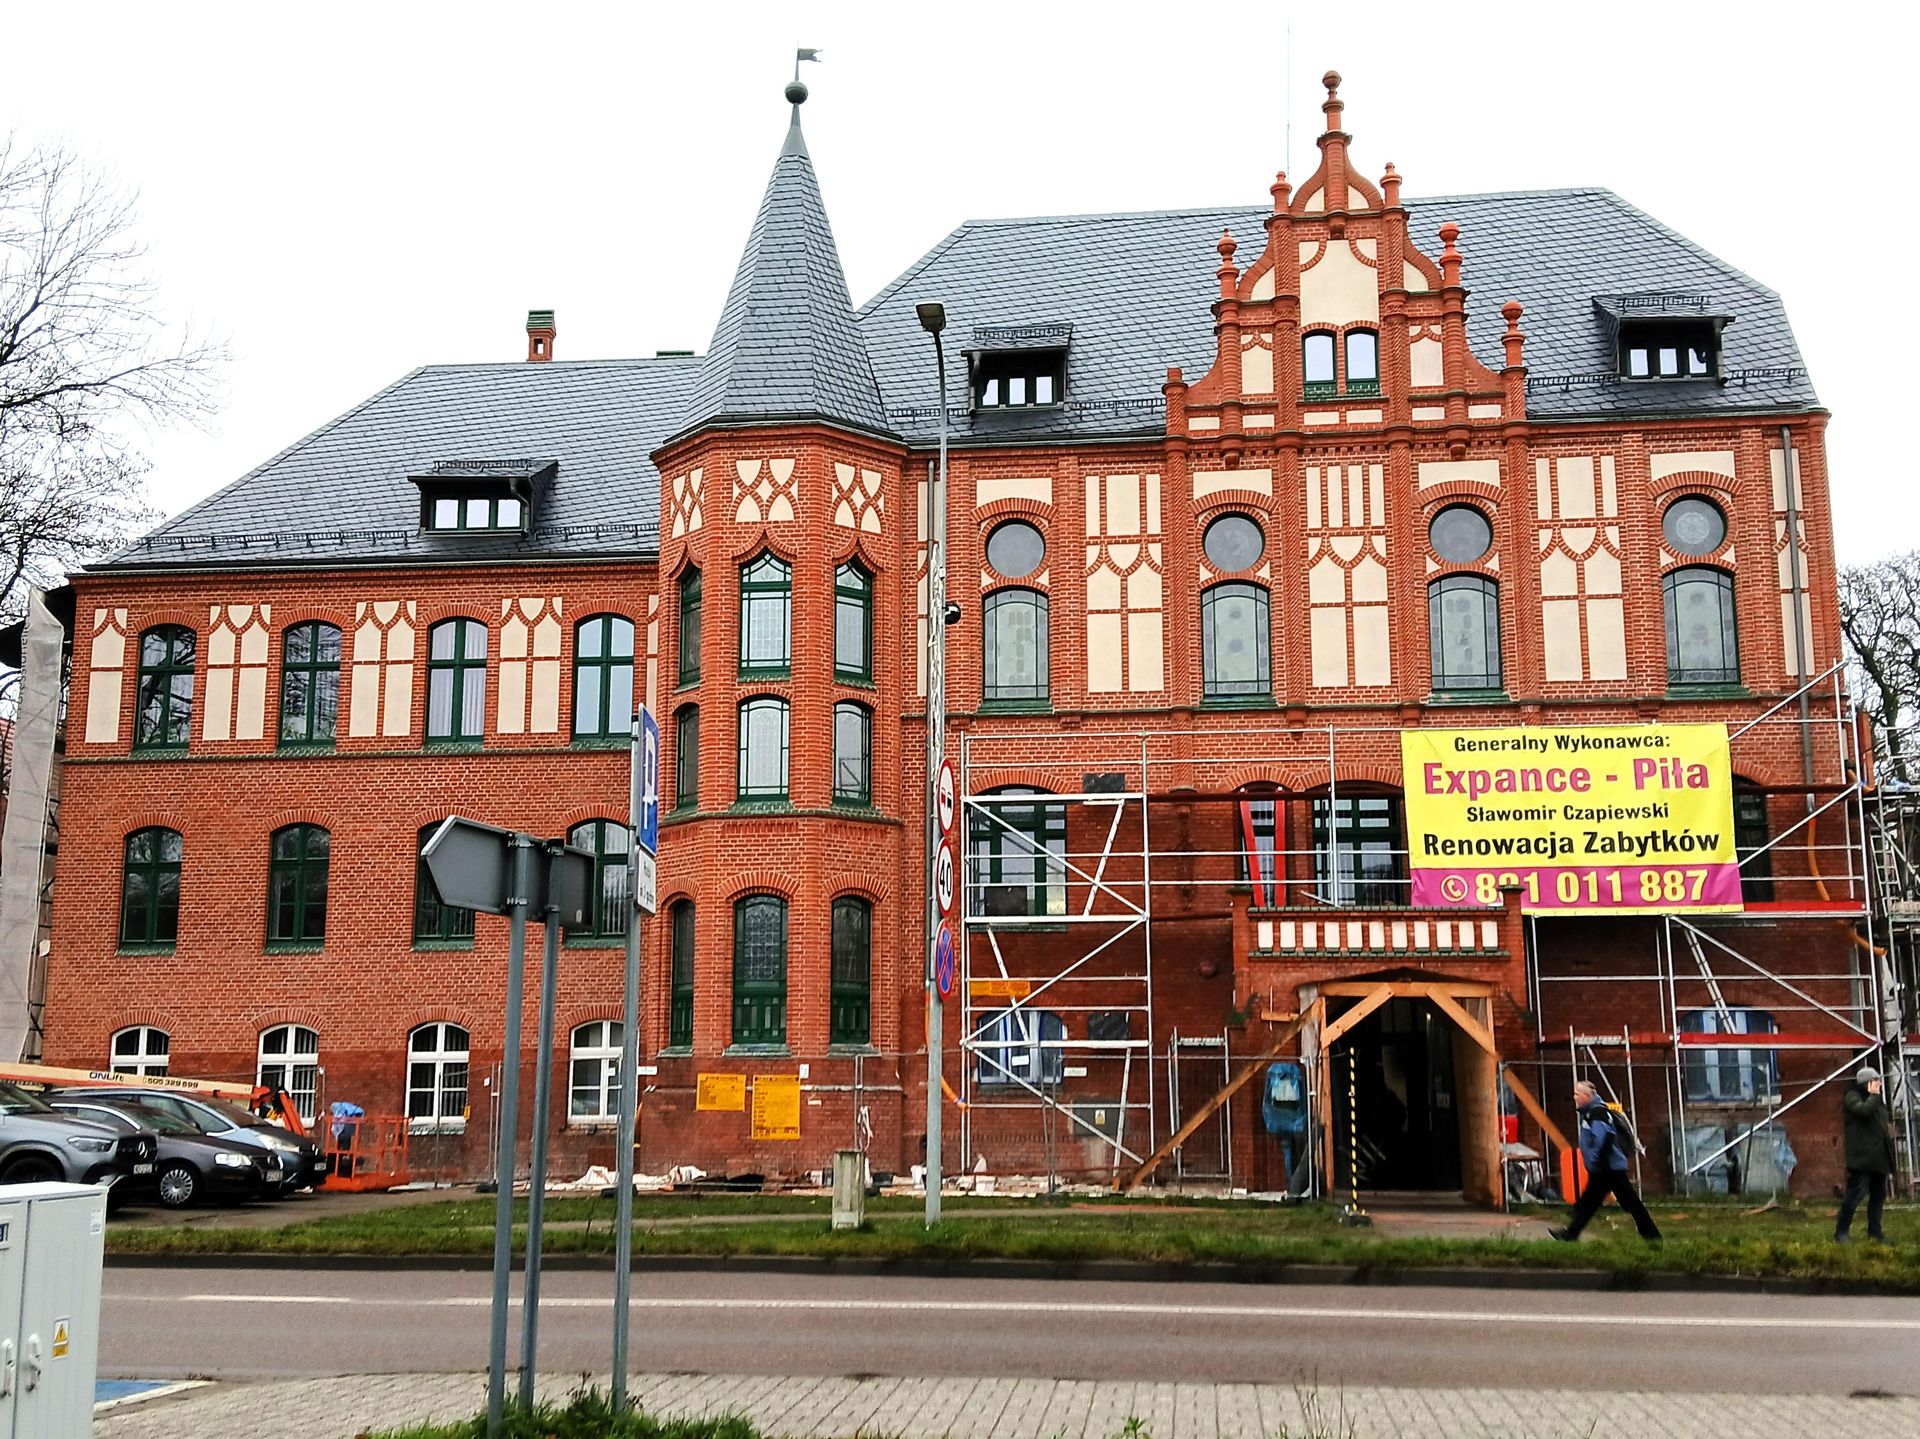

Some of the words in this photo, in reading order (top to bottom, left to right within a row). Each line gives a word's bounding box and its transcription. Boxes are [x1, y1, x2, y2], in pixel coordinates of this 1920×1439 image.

[1454, 735, 1549, 753] Generalny
[1554, 734, 1670, 753] Wykonawca:
[1424, 762, 1591, 801] Expance
[1606, 774, 1618, 782] -
[1633, 757, 1709, 790] Piła
[1467, 804, 1557, 822] Sławomir
[1563, 803, 1669, 823] Czapiewski
[1424, 832, 1574, 859] Renowacja
[1583, 829, 1719, 857] Zabytków
[940, 859, 952, 898] 40
[1556, 869, 1623, 903] 011
[1639, 868, 1708, 902] 887
